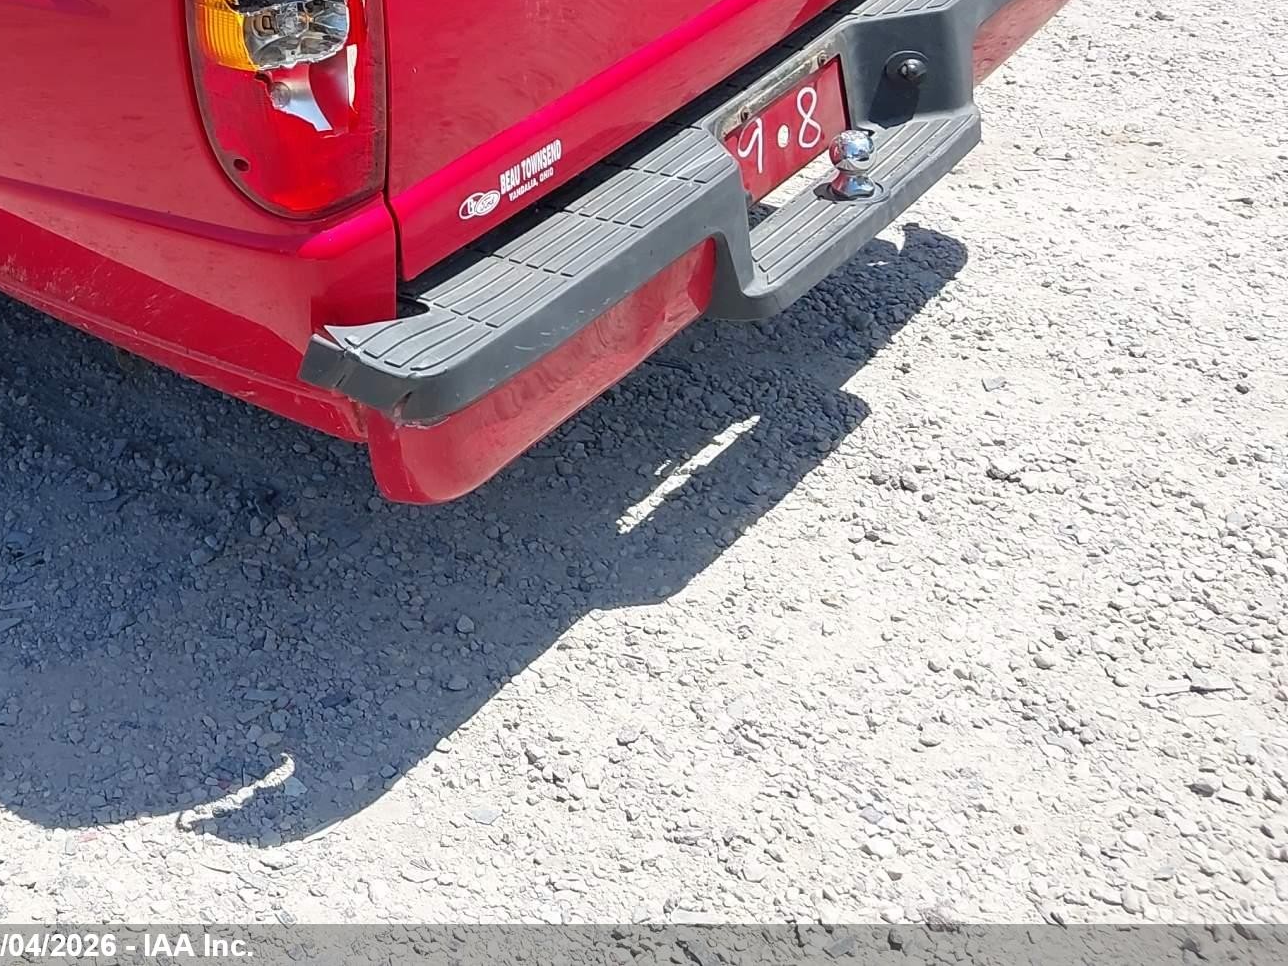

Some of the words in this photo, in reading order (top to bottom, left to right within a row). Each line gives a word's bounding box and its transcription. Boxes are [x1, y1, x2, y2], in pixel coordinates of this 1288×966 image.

[499, 165, 521, 195] BEAU
[520, 139, 562, 181] TOWNSEND
[539, 166, 554, 183] OHIO
